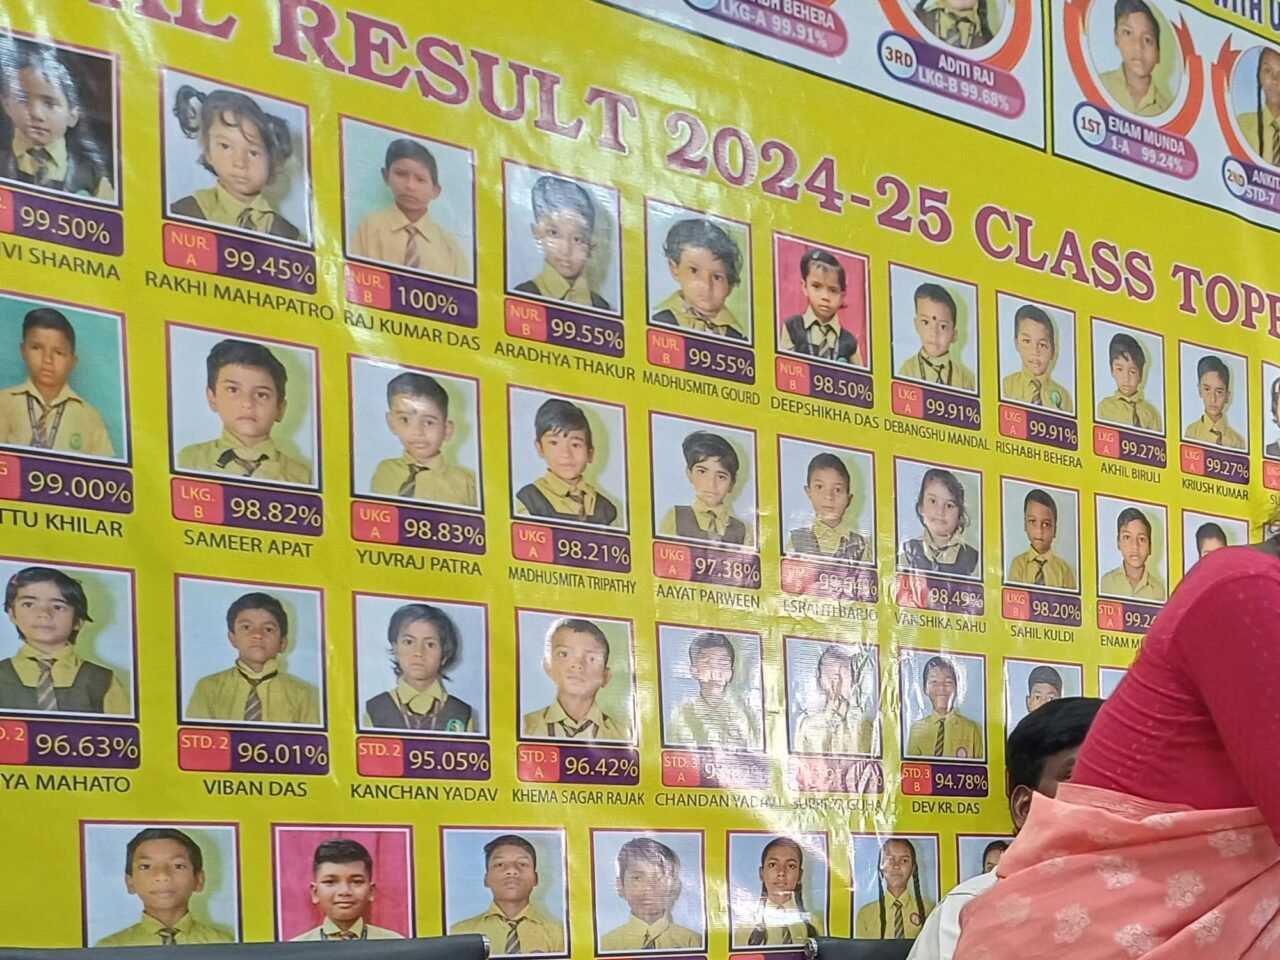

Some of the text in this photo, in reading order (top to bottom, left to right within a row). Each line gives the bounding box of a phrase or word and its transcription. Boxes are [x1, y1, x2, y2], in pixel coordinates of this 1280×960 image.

[720, 0, 829, 49] LKG-A 99.91%
[784, 0, 836, 30] BEHERA
[884, 46, 914, 68] 3RD
[918, 69, 958, 94] LKG-B
[938, 54, 995, 88] ADITI RAJ
[272, 0, 953, 244] RESULT 2024-25
[1080, 115, 1102, 137] 1ST
[1108, 115, 1186, 156] ENAM MUNDA
[19, 205, 111, 247] 99.50%
[29, 246, 122, 281] SHARMA
[185, 252, 198, 267] A
[974, 204, 1156, 303] CLASS
[224, 247, 316, 287] 99.45%
[145, 270, 335, 322] RAKHI MAHAPATRO
[363, 290, 373, 303] B
[397, 285, 459, 317] 100%
[344, 309, 481, 351] RAJ KUMAR DAS
[521, 323, 532, 336] B
[550, 318, 624, 351] 99.55%
[494, 341, 637, 382] ARADHYA THAKUR
[661, 353, 671, 365] B
[688, 348, 755, 378] 99.55%
[642, 369, 761, 406] MADHUSMITA GOURD
[788, 379, 798, 391] B
[813, 374, 873, 402] 98.50%
[897, 387, 918, 401] LKG
[770, 396, 880, 430] DEEPSHIKHA DAS
[904, 403, 912, 414] A
[925, 398, 981, 425] 99.91%
[1004, 409, 1022, 424] LKG
[884, 418, 991, 451] DEBANGSHU MANDAL
[1029, 419, 1078, 445] 99.91%
[1098, 431, 1115, 443] LKG
[995, 440, 1083, 469] RISHABH BEHERA
[1120, 439, 1167, 462] 99.27%
[1101, 462, 1162, 484] AKHIL BIRULI
[1206, 457, 1249, 480] 99.27%
[27, 470, 132, 505] 99.00%
[181, 484, 215, 503] LKG.
[1181, 477, 1215, 495] KRIUSH
[1216, 483, 1249, 501] KUMAR
[193, 506, 204, 519] B
[230, 497, 322, 529] 98.82%
[359, 507, 392, 524] UKG
[46, 513, 124, 538] KHILAR
[369, 527, 381, 540] A
[403, 517, 485, 547] 98.83%
[519, 528, 547, 544] UKG
[184, 528, 314, 559] SAMEER APAT
[527, 546, 538, 559] A
[557, 539, 631, 566] 98.21%
[659, 547, 685, 562] UKG
[356, 549, 483, 576] YUVRAJ PATRA
[694, 557, 760, 583] 97.38%
[508, 565, 637, 595] MADHUSMITA TRIPATHY
[656, 584, 761, 609] AAYAT PARWEEN
[930, 587, 984, 609] 98.49%
[1007, 592, 1026, 606] UKG
[1032, 600, 1082, 622] 98.20%
[955, 619, 987, 634] SAHU
[1010, 625, 1075, 643] SAHIL KULDI
[1100, 634, 1130, 649] ENAM
[34, 733, 139, 760] 96.63%
[181, 735, 214, 750] STD.
[359, 742, 389, 756] STD.
[237, 742, 328, 766] 96.01%
[408, 749, 490, 772] 95.05%
[519, 749, 548, 763] STD.
[663, 755, 690, 769] STD.
[533, 767, 544, 779] A
[564, 756, 639, 778] 96.42%
[676, 771, 687, 783] A
[902, 767, 923, 780] STD.
[35, 774, 132, 793] MAHATO
[203, 779, 308, 798] VIBAN DAS
[350, 783, 499, 802] KANCHAN YADAV
[934, 772, 988, 791] 94.78%
[512, 788, 646, 806] KHEMA SAGAR RAJAK
[654, 792, 729, 809] CHANDAN
[912, 800, 981, 815] DEV KR. DAS
